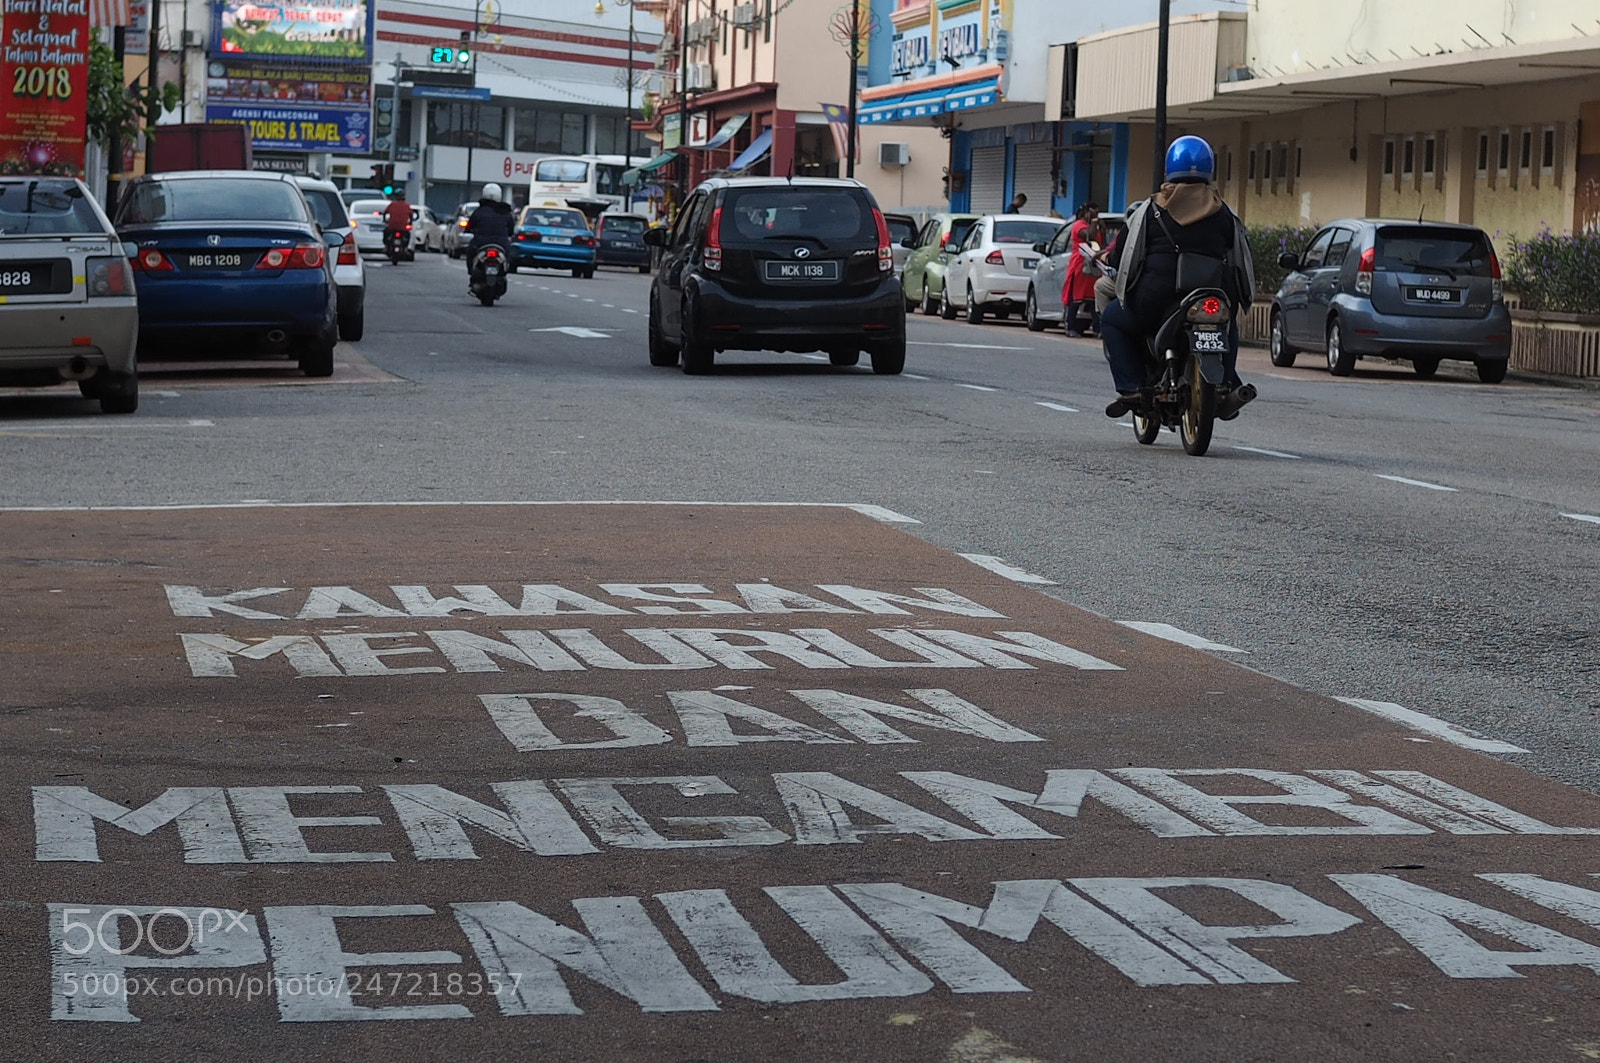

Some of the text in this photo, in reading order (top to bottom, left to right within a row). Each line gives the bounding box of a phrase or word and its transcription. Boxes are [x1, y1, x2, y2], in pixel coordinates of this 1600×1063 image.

[5, 0, 87, 15] Hari Natal
[38, 14, 49, 31] &
[12, 28, 77, 48] Selamat
[5, 46, 84, 65] Tahun Baharu
[432, 48, 453, 63] 27
[13, 66, 72, 99] 2018
[232, 109, 319, 120] AGENSI PELANCONGAN
[250, 121, 287, 140] TOURS
[288, 122, 298, 140] &
[300, 123, 341, 141] TRAVEL
[189, 254, 241, 266] MBG 1208
[781, 265, 824, 276] MCK 1138
[0, 271, 31, 286] 828
[1431, 290, 1451, 300] 4499
[1197, 332, 1220, 341] MBR
[1195, 340, 1225, 350] 6432
[163, 584, 1010, 620] KAWASAN
[177, 628, 1127, 679] MENURUN
[478, 688, 1046, 752] DAN
